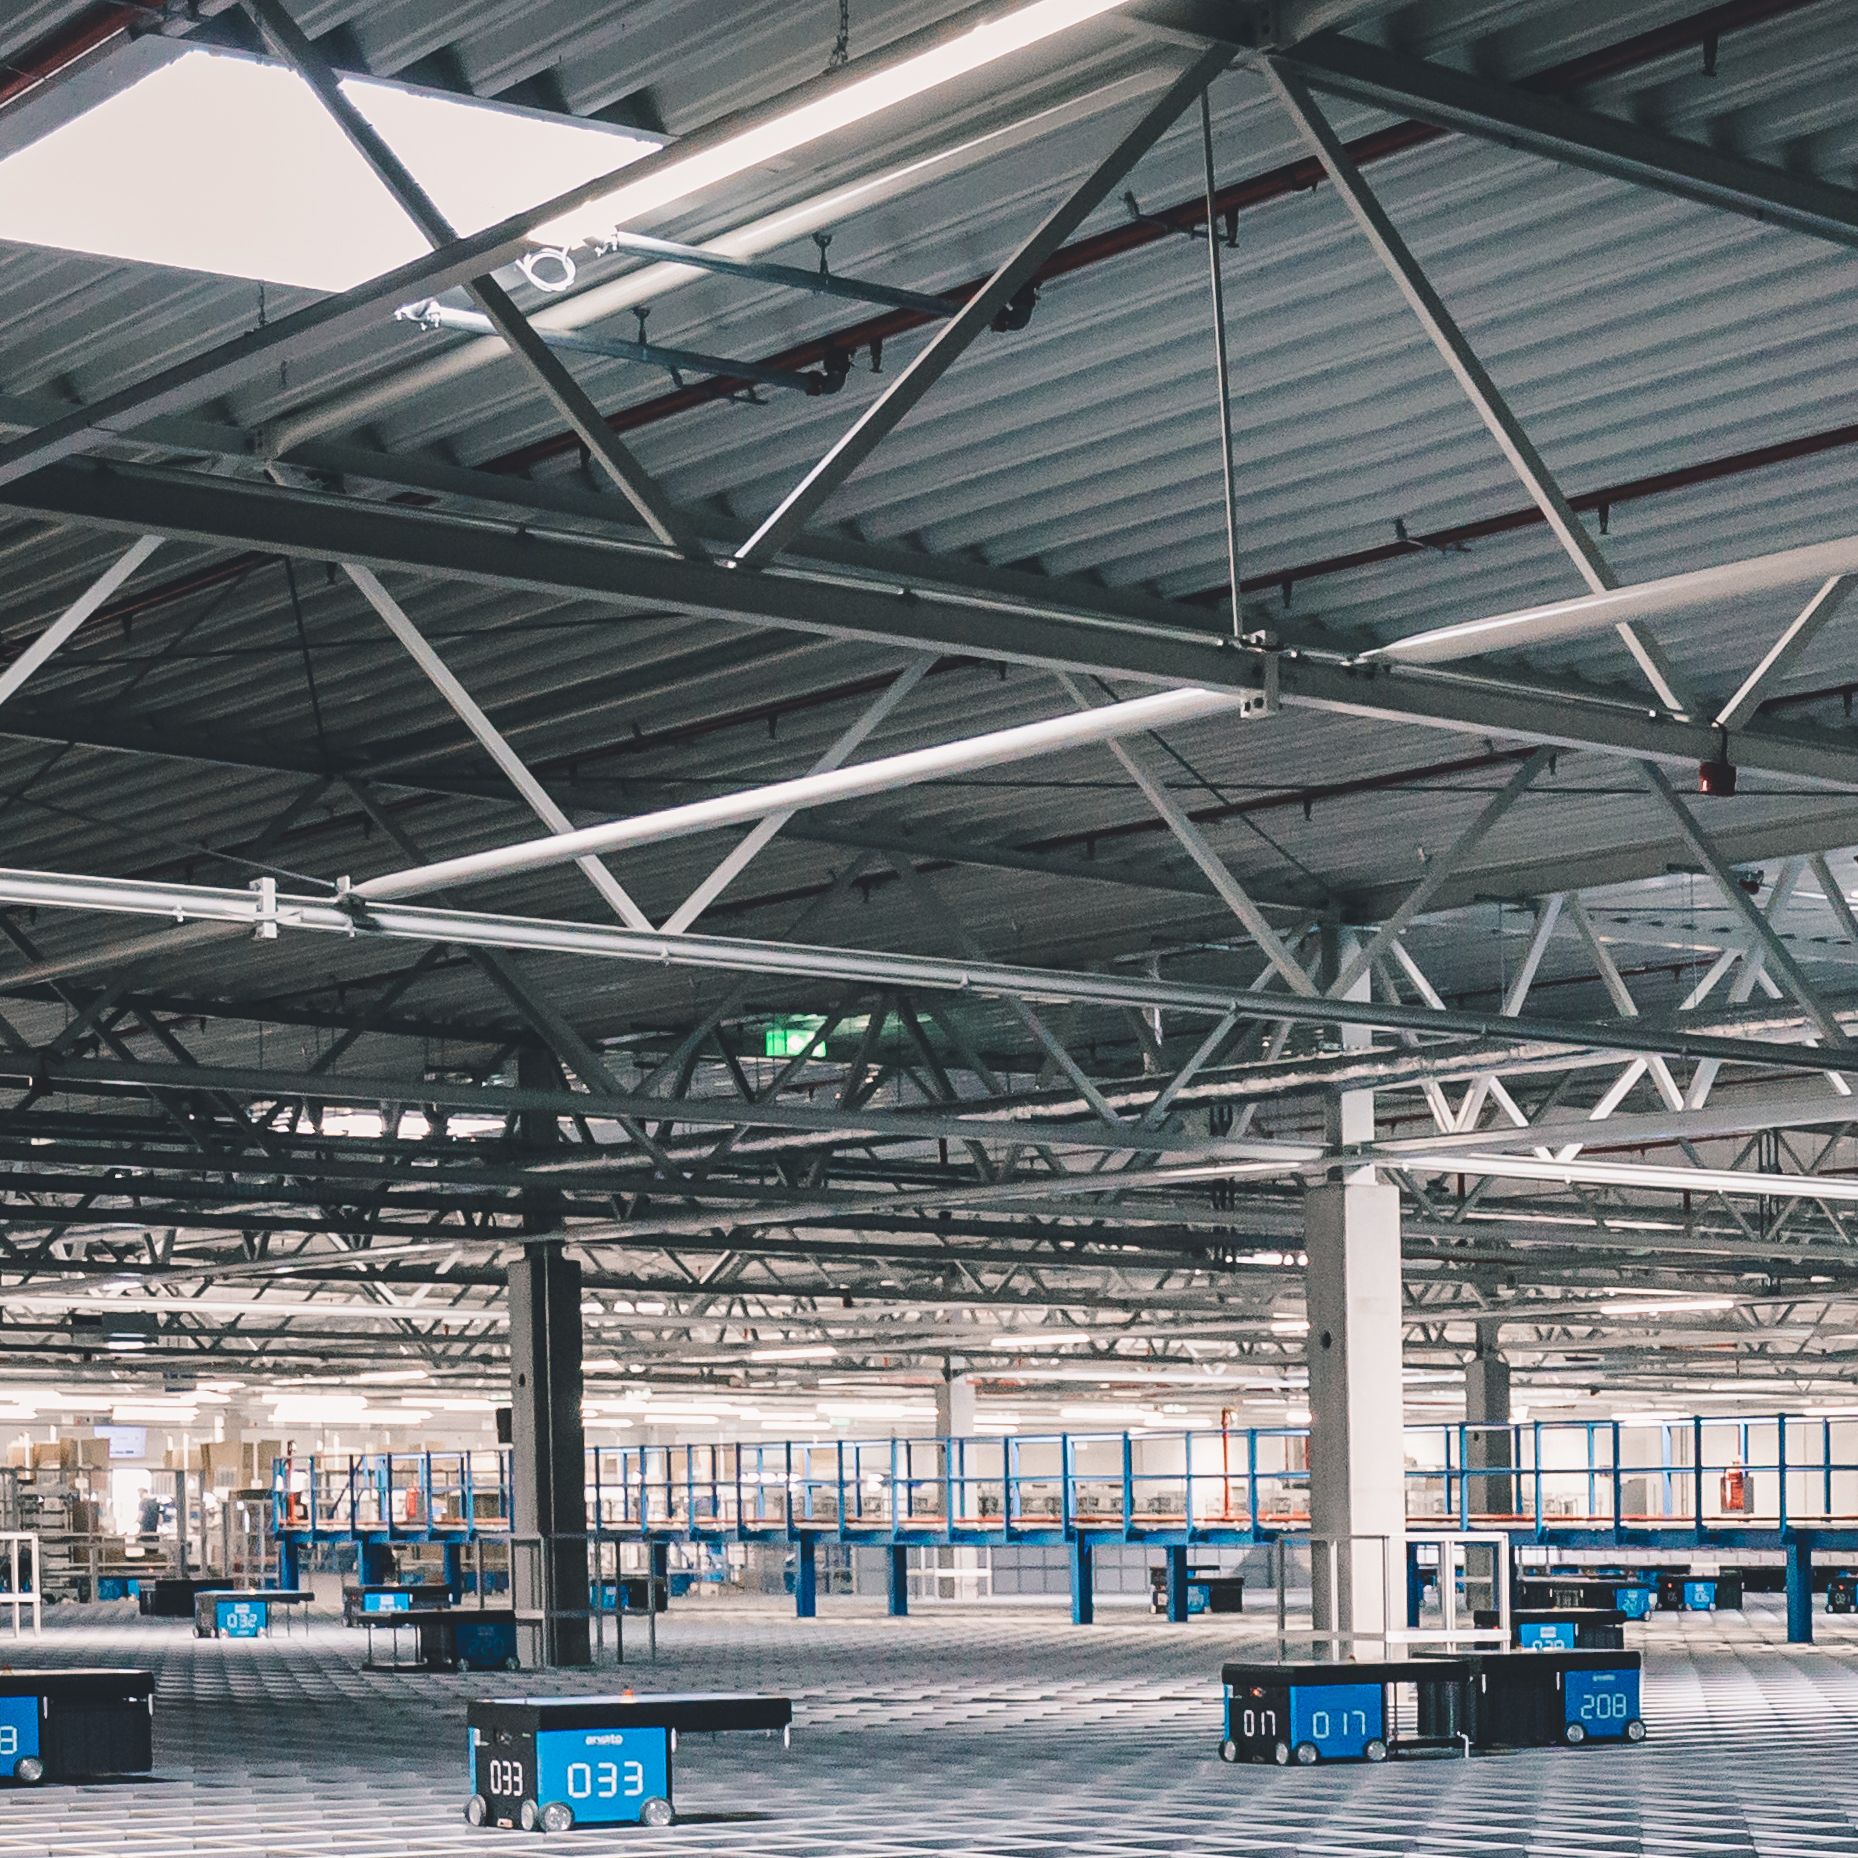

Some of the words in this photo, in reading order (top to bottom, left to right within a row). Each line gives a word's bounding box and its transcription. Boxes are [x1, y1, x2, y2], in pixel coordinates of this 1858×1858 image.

[227, 1613, 257, 1628] 032
[1580, 1693, 1627, 1720] 208
[1243, 1709, 1276, 1737] 017
[1312, 1710, 1366, 1738] 017
[489, 1760, 524, 1797] 033
[567, 1760, 644, 1799] 033
